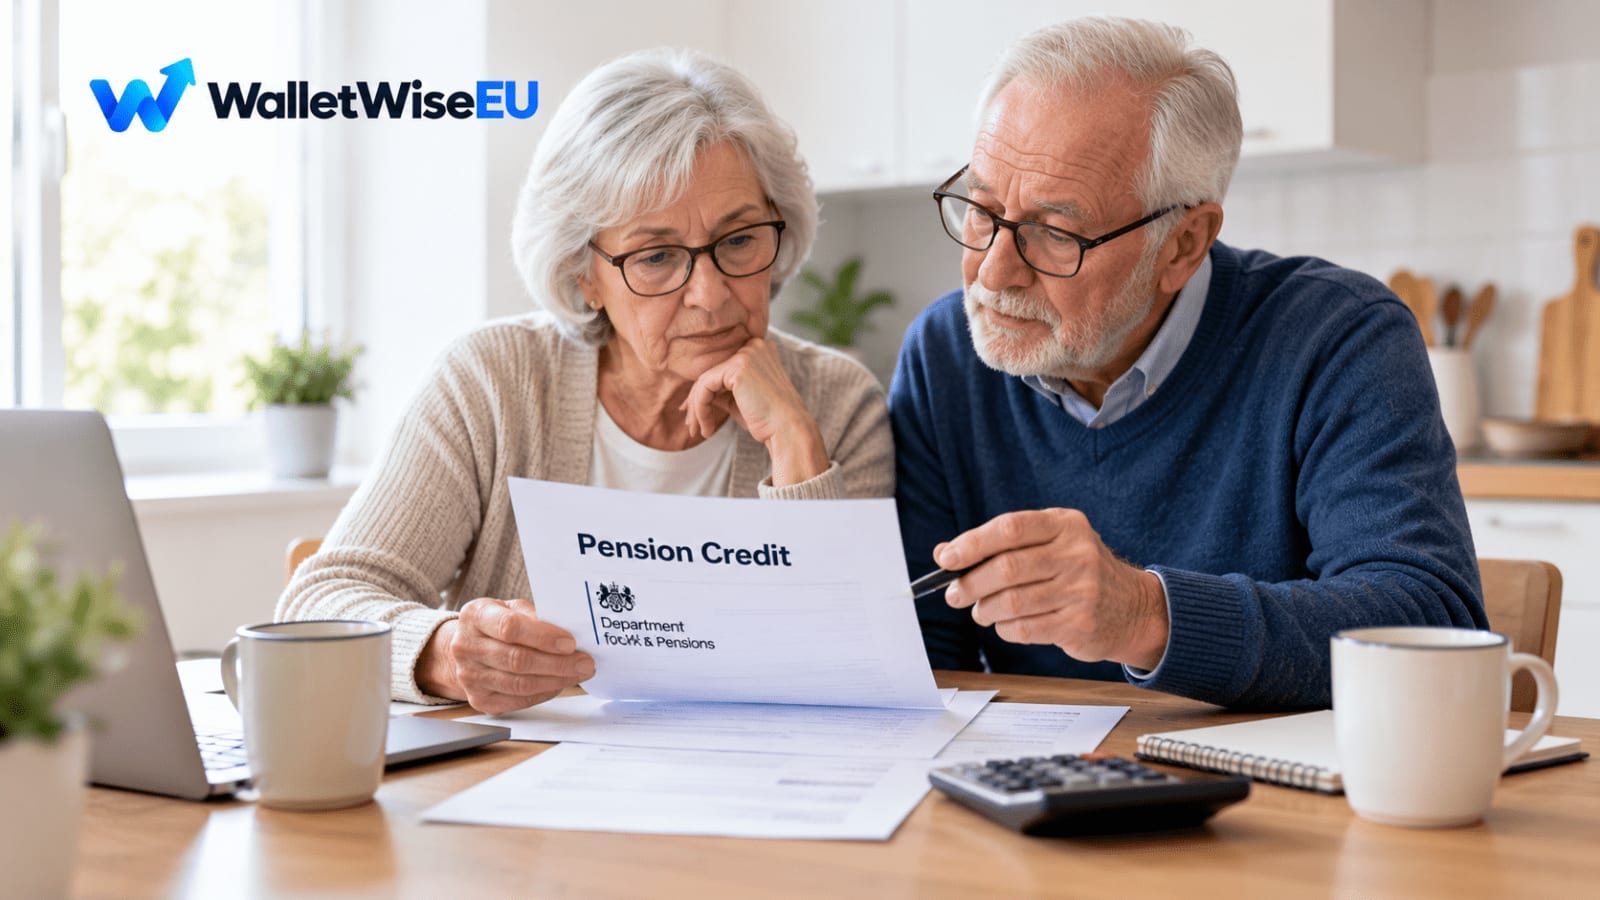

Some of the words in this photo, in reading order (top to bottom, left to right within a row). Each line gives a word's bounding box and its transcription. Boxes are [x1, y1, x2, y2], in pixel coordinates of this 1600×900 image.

[577, 532, 694, 563] Pension
[701, 541, 793, 567] Credit
[600, 616, 685, 633] Department
[644, 637, 654, 647] &
[656, 637, 716, 650] Pensions
